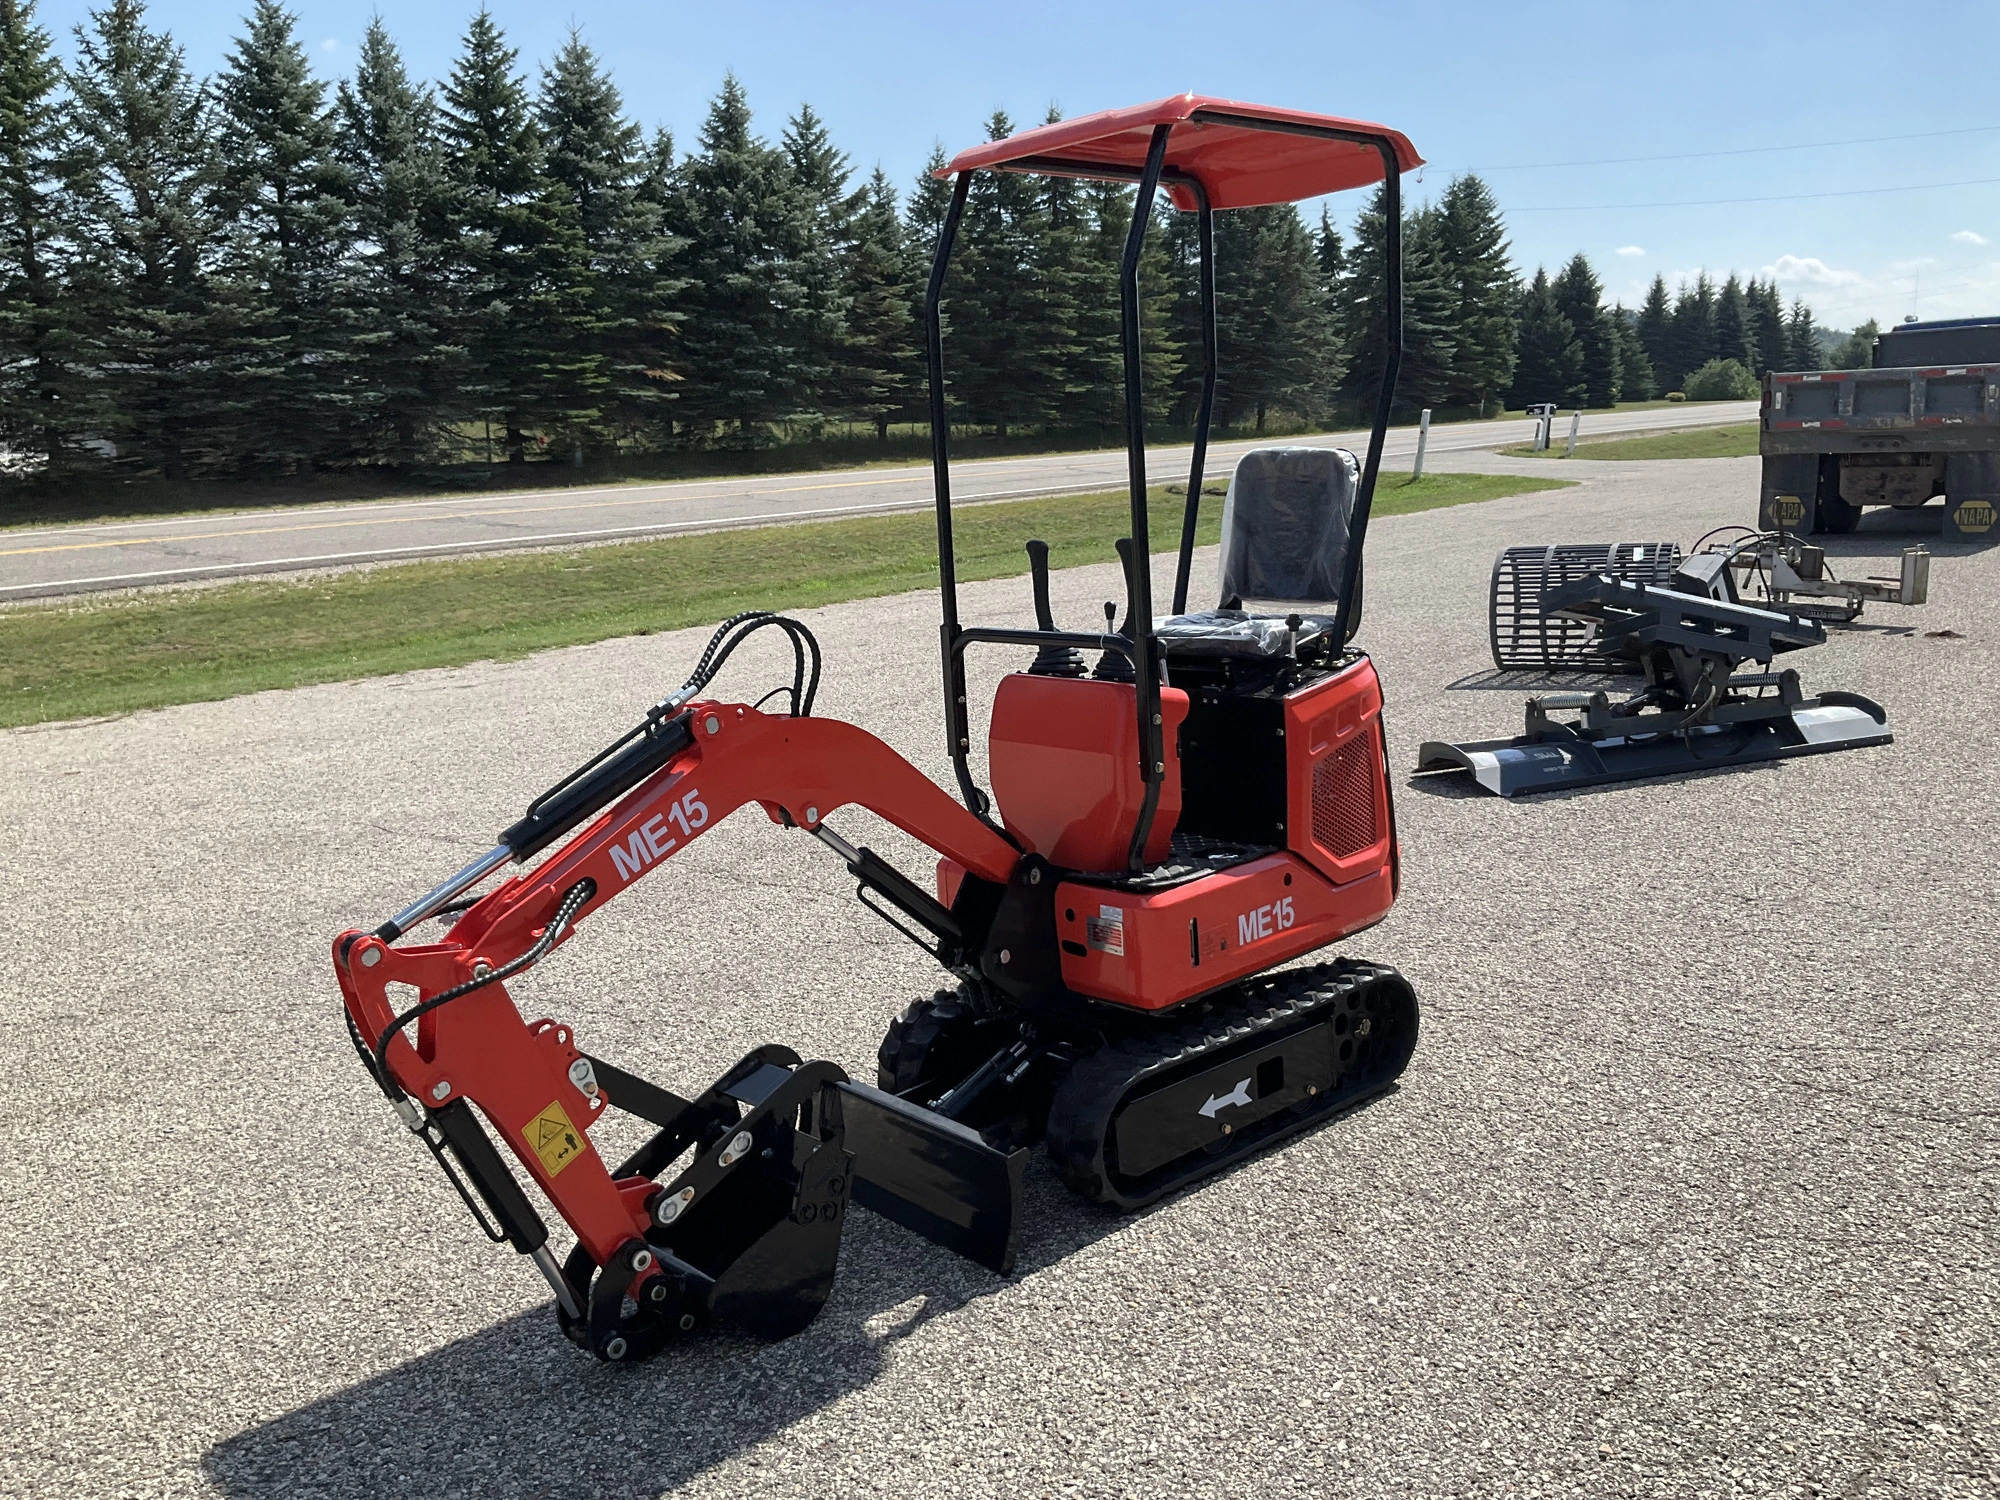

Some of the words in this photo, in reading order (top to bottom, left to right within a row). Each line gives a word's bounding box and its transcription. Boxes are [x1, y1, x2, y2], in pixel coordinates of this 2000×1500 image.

[1960, 508, 1990, 525] NAPA
[608, 788, 709, 882] ME15
[1238, 896, 1295, 946] ME15
